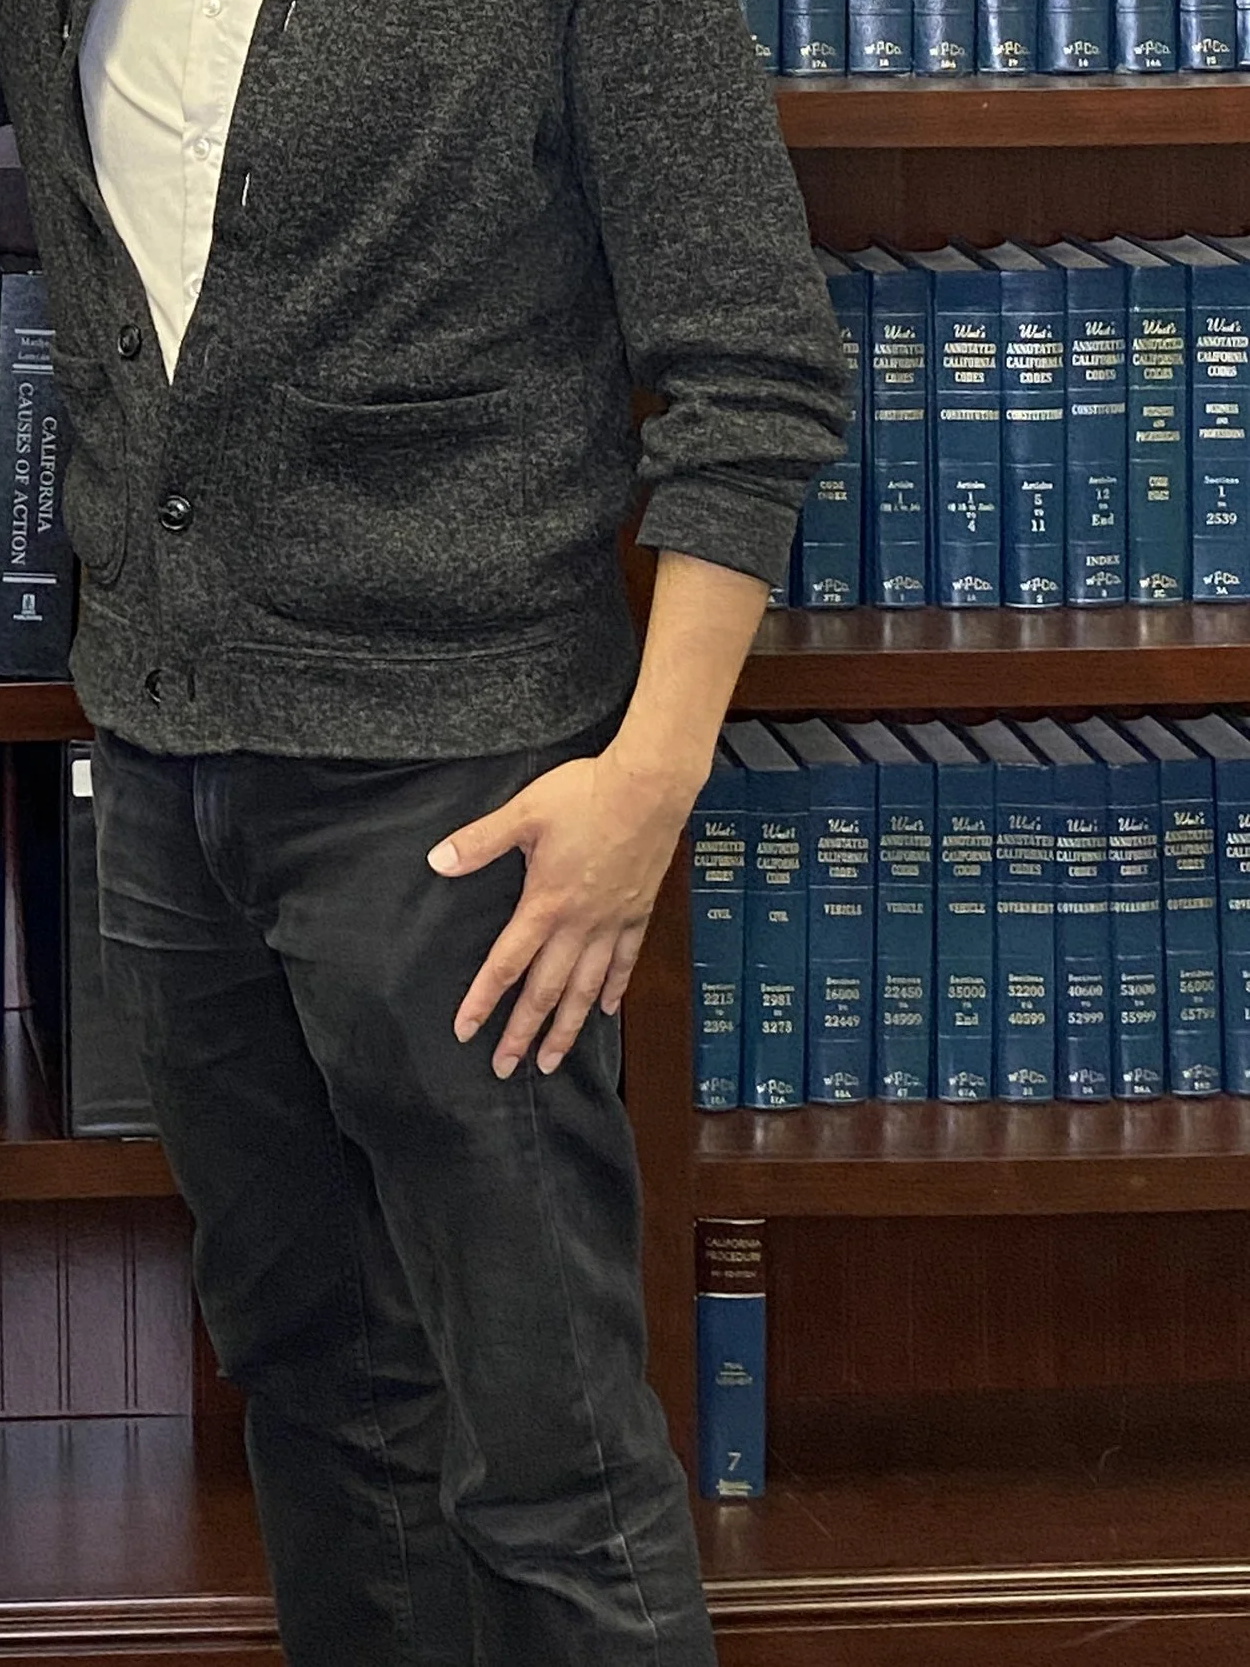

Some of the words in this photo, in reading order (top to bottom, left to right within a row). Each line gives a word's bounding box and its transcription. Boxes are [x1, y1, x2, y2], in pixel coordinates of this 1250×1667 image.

[16, 382, 34, 453] CAUSES
[14, 459, 30, 485] OF
[37, 416, 58, 533] CALIFORNIA
[1031, 520, 1045, 531] 11
[1092, 514, 1114, 526] End
[1206, 513, 1237, 524] 2539
[11, 492, 28, 565] ACTION
[1086, 555, 1120, 566] INDEX
[727, 1452, 741, 1471] 7
